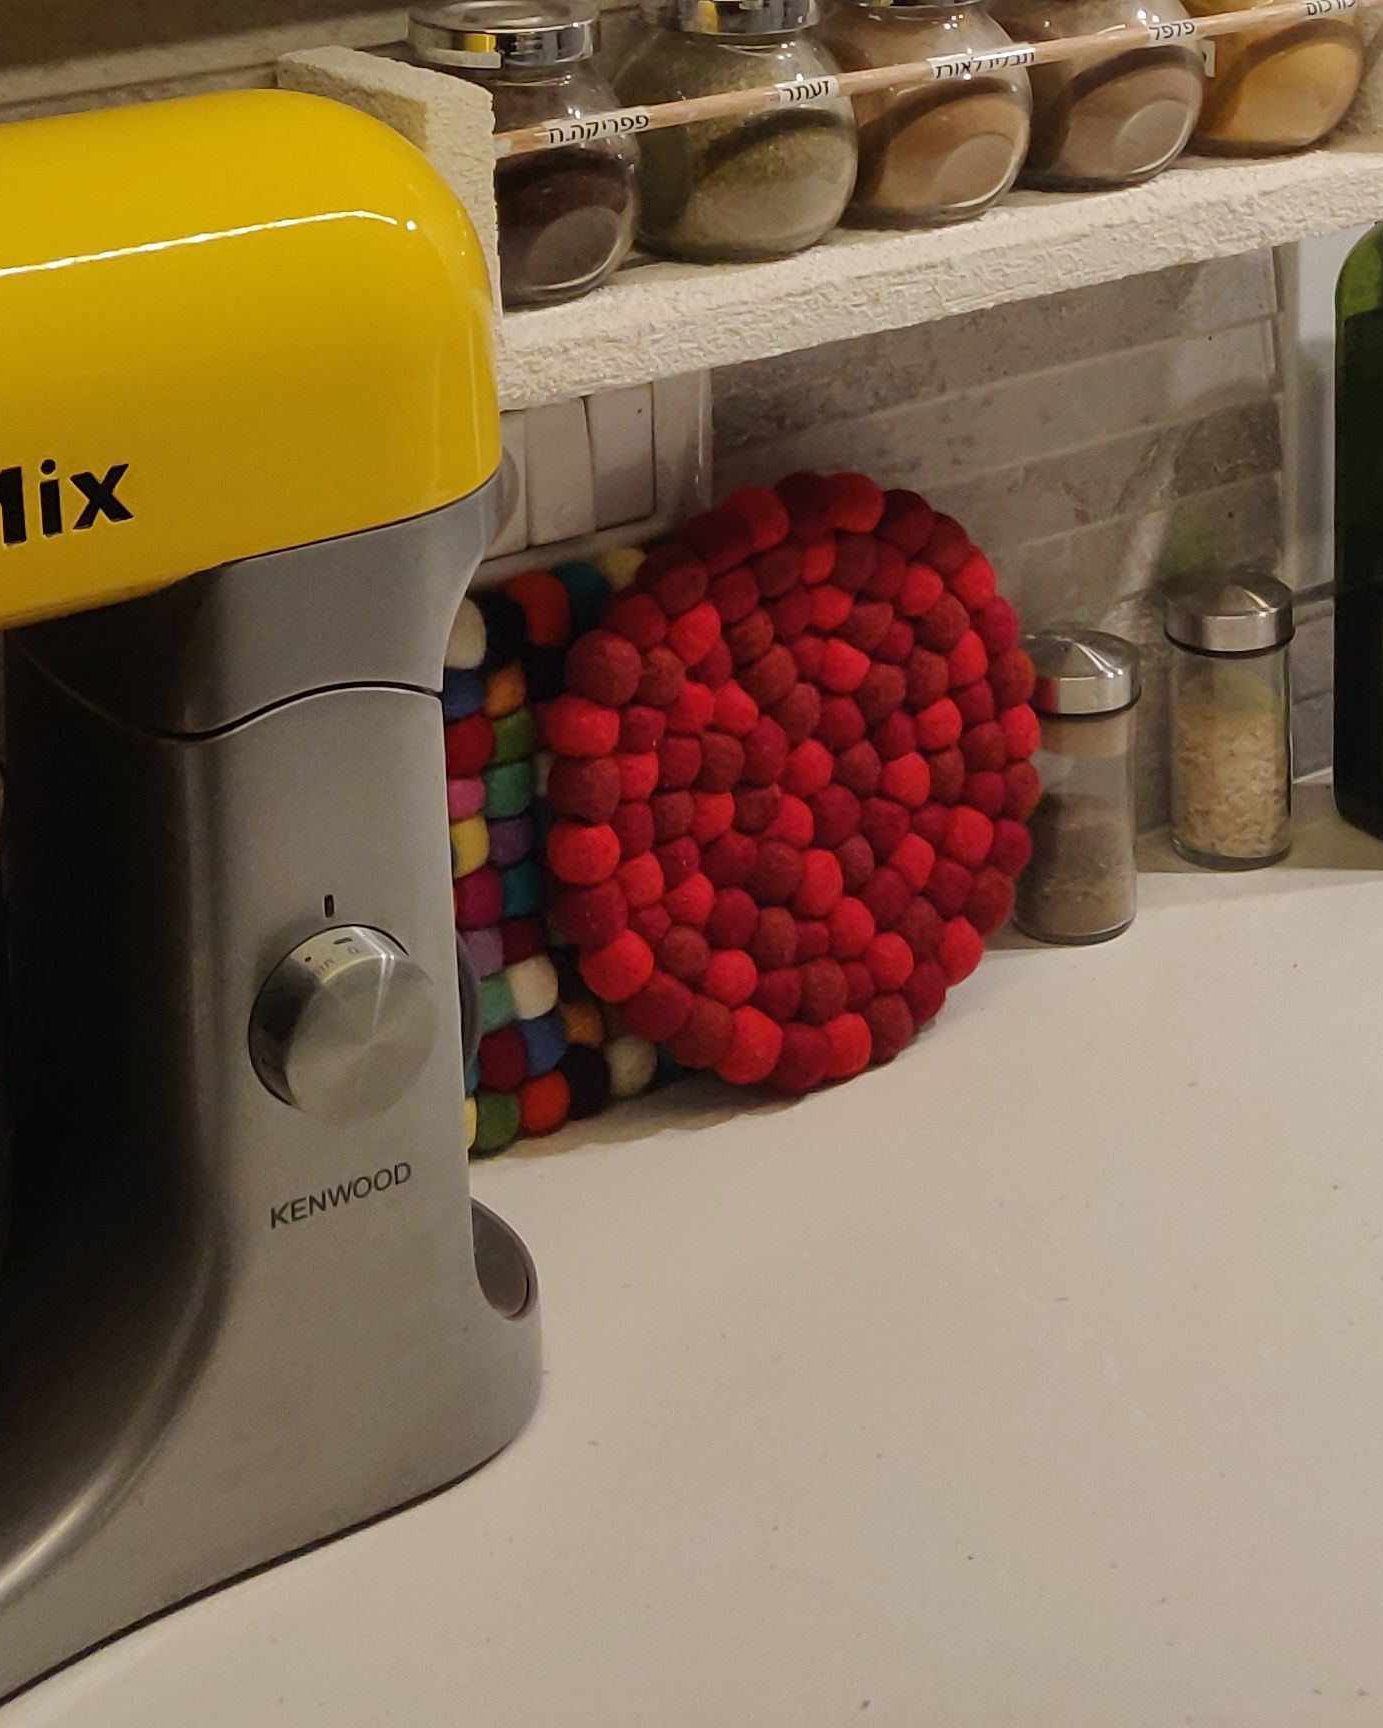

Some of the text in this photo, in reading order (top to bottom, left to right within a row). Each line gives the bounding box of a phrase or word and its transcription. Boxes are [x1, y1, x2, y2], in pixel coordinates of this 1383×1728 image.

[1149, 21, 1195, 41] פלפל
[782, 80, 829, 102] זעתר
[270, 1162, 412, 1230] KENWOOD
